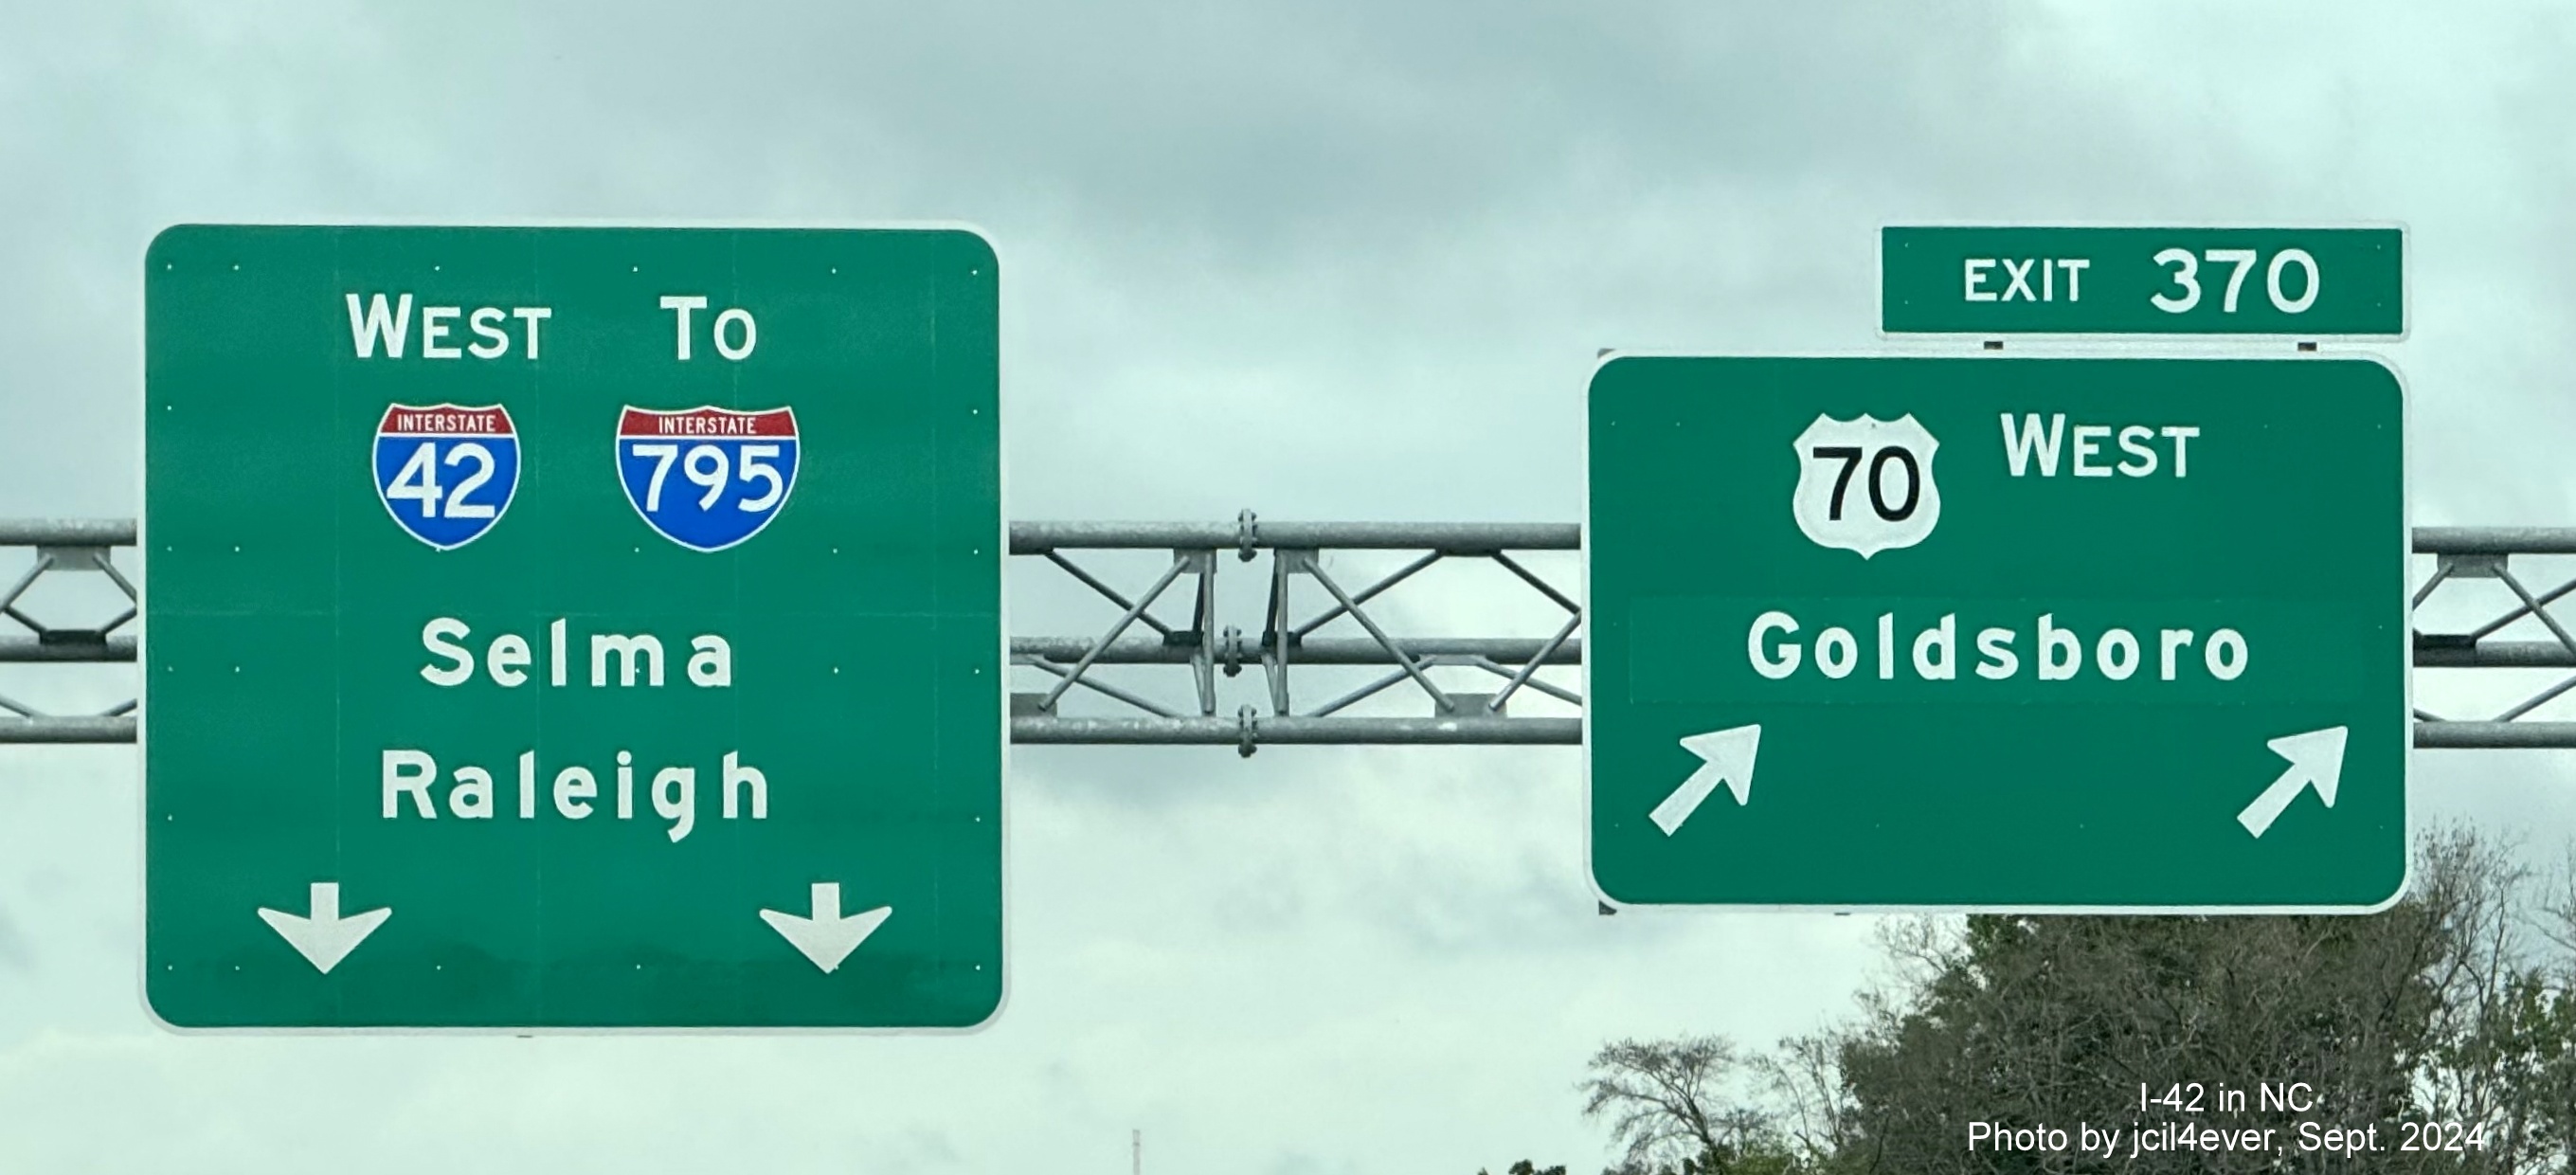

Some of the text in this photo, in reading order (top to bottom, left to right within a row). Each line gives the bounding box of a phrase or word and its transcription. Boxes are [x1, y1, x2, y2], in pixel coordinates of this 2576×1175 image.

[1965, 248, 2320, 314] EXIT 370
[345, 293, 552, 359] WEST
[396, 413, 495, 433] INTERSTATE
[658, 415, 757, 434] INTERSTATE
[2000, 413, 2200, 478] WEST
[386, 442, 495, 519] 42
[631, 444, 784, 513] 795
[1812, 445, 1920, 522] 70
[420, 617, 731, 687] Selma
[1748, 611, 2248, 680] Goldsboro
[382, 750, 767, 843] Raleigh
